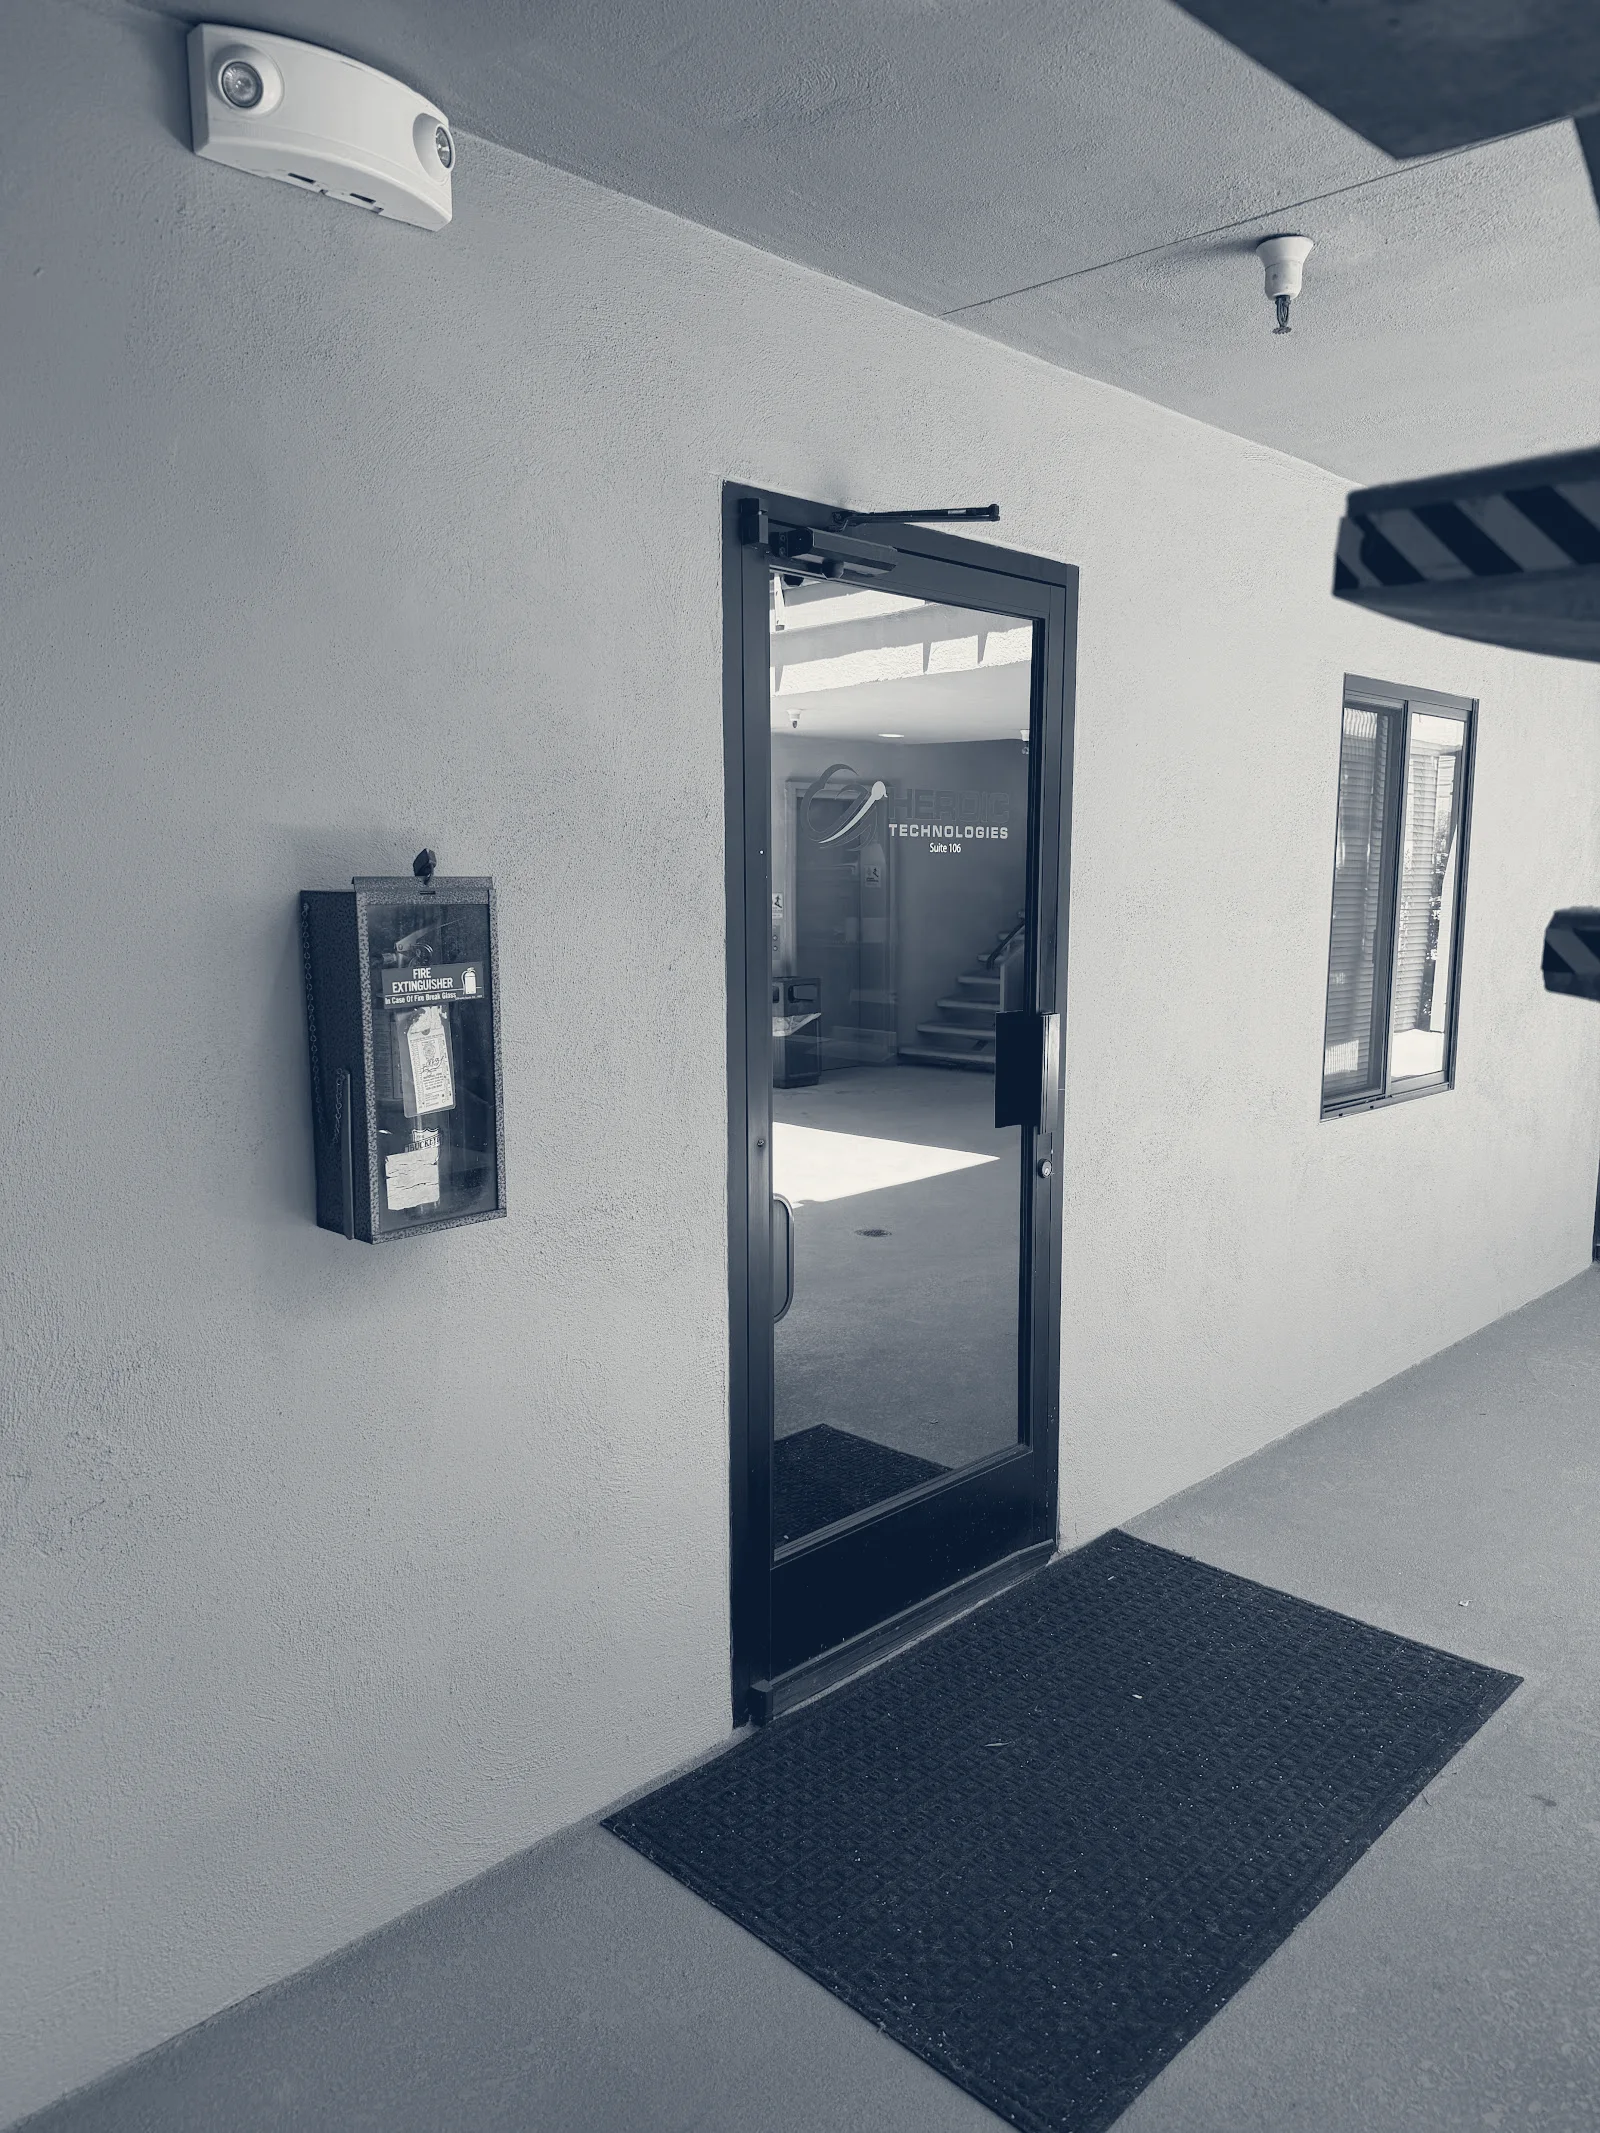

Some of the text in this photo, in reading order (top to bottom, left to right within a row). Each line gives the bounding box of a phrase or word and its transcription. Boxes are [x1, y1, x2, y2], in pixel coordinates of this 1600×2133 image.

[889, 787, 1010, 823] HEROIC
[889, 823, 1009, 840] TECHNOLOGIES
[929, 843, 962, 854] Suite 106
[412, 967, 432, 980] FIRE
[392, 977, 454, 993] EXTINGUISHER
[385, 997, 391, 1005] In
[391, 996, 406, 1005] Case
[406, 995, 413, 1003] Of
[414, 994, 425, 1002] Fire
[425, 993, 441, 1001] Break
[442, 991, 457, 1000] Glass
